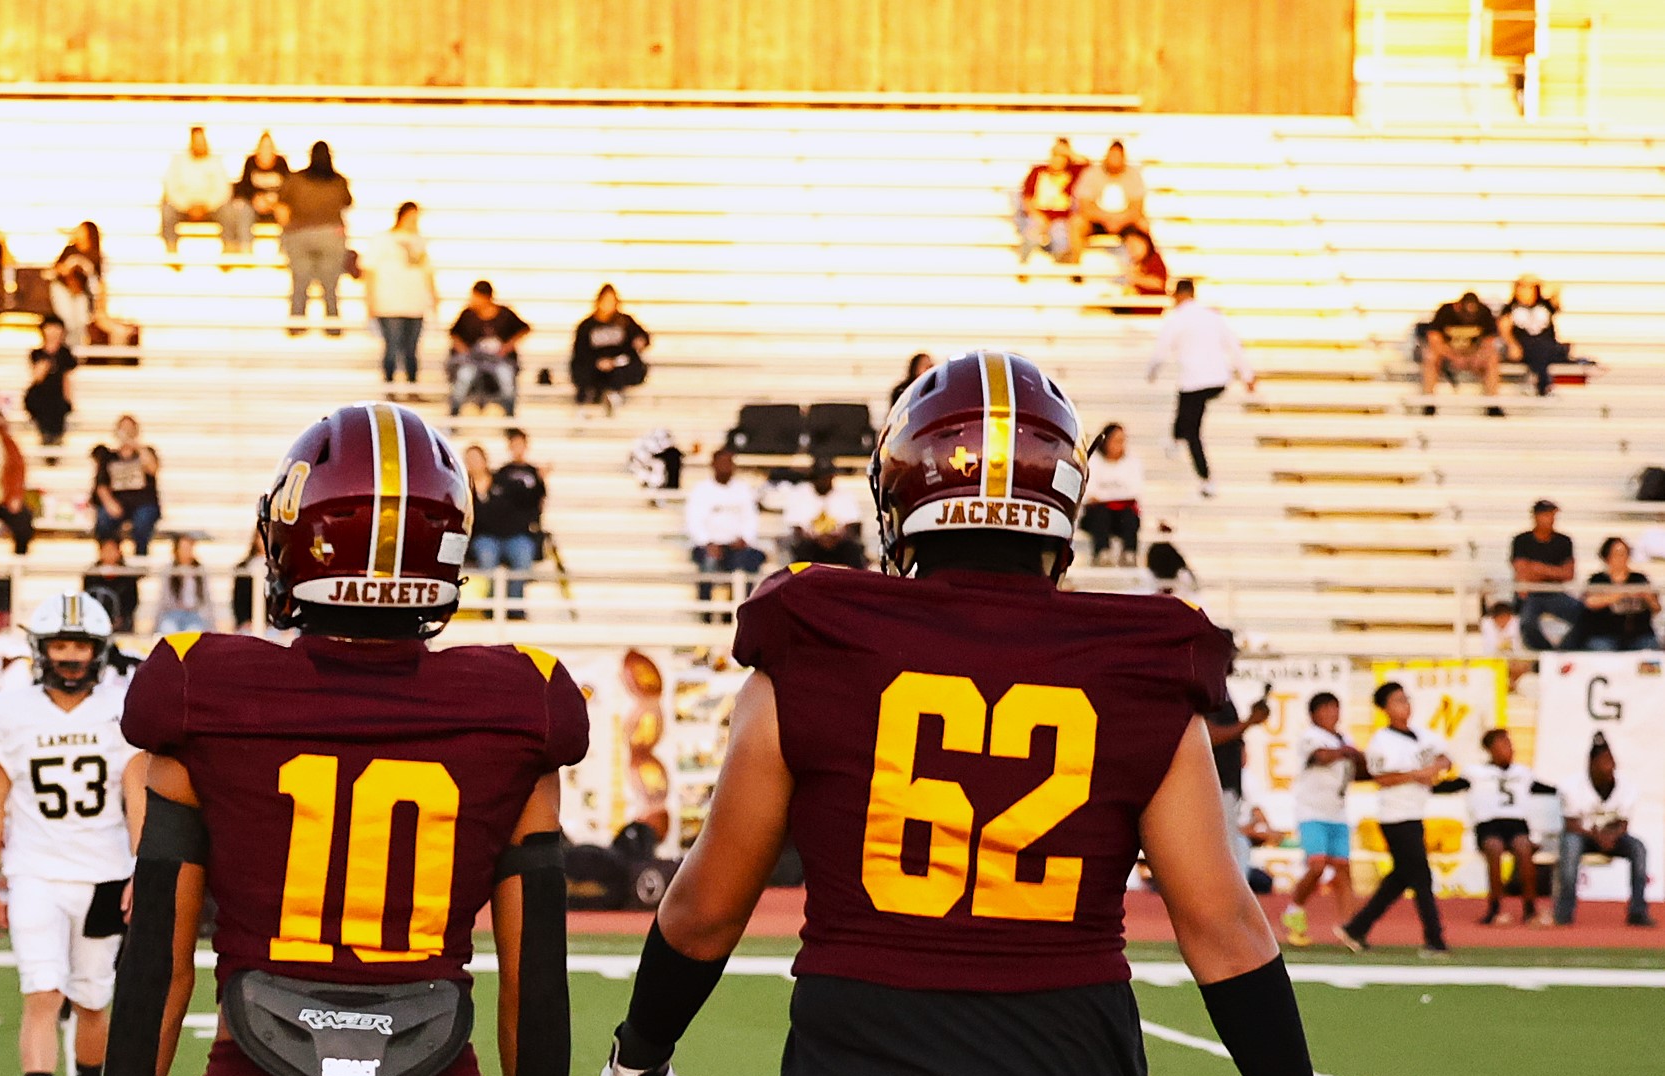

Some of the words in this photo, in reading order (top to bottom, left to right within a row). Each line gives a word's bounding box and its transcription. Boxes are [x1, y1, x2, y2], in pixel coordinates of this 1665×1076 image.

[935, 501, 1051, 529] JACKETS
[328, 581, 440, 604] JACKETS
[29, 754, 108, 820] 53
[861, 671, 1098, 922] 62
[269, 753, 460, 963] 10
